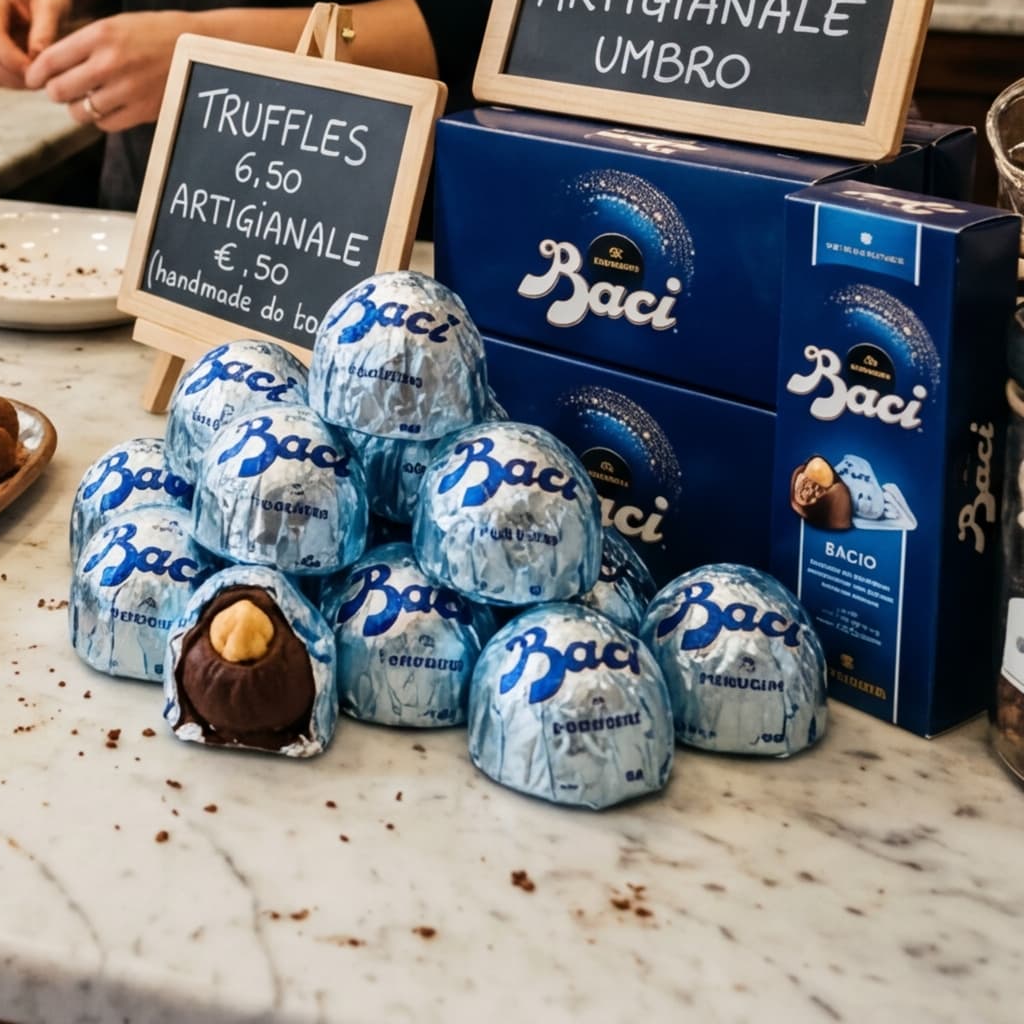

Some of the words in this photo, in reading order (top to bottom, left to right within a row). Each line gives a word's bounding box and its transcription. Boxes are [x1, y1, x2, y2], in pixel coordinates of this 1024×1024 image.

[594, 36, 750, 89] UMBRO
[198, 88, 368, 166] TRUFFLES
[235, 151, 302, 194] 6,50
[327, 283, 460, 344] Baci
[517, 238, 683, 331] Baci
[293, 302, 319, 334] to
[786, 345, 927, 429] Baci
[958, 422, 996, 554] Baci
[825, 541, 877, 570] BACIO
